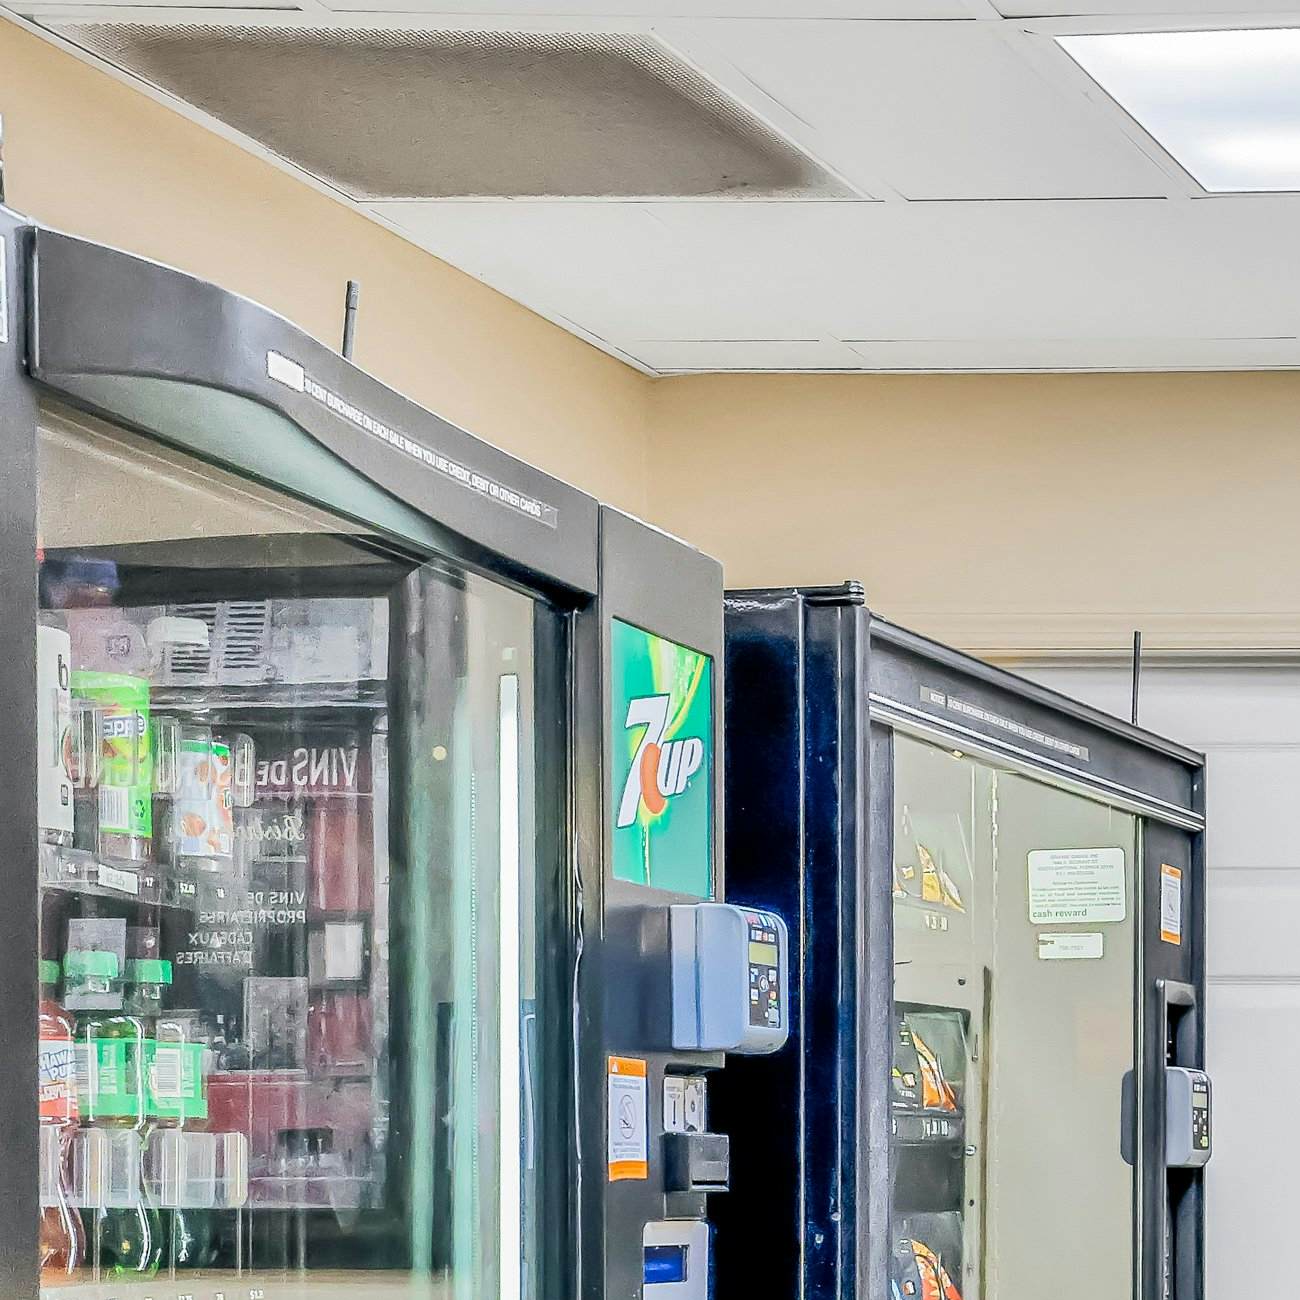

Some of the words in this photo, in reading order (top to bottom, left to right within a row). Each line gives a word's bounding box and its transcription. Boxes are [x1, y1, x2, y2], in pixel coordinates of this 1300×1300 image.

[615, 693, 704, 830] 7UP
[1033, 909, 1053, 918] cash
[1055, 908, 1087, 917] reward
